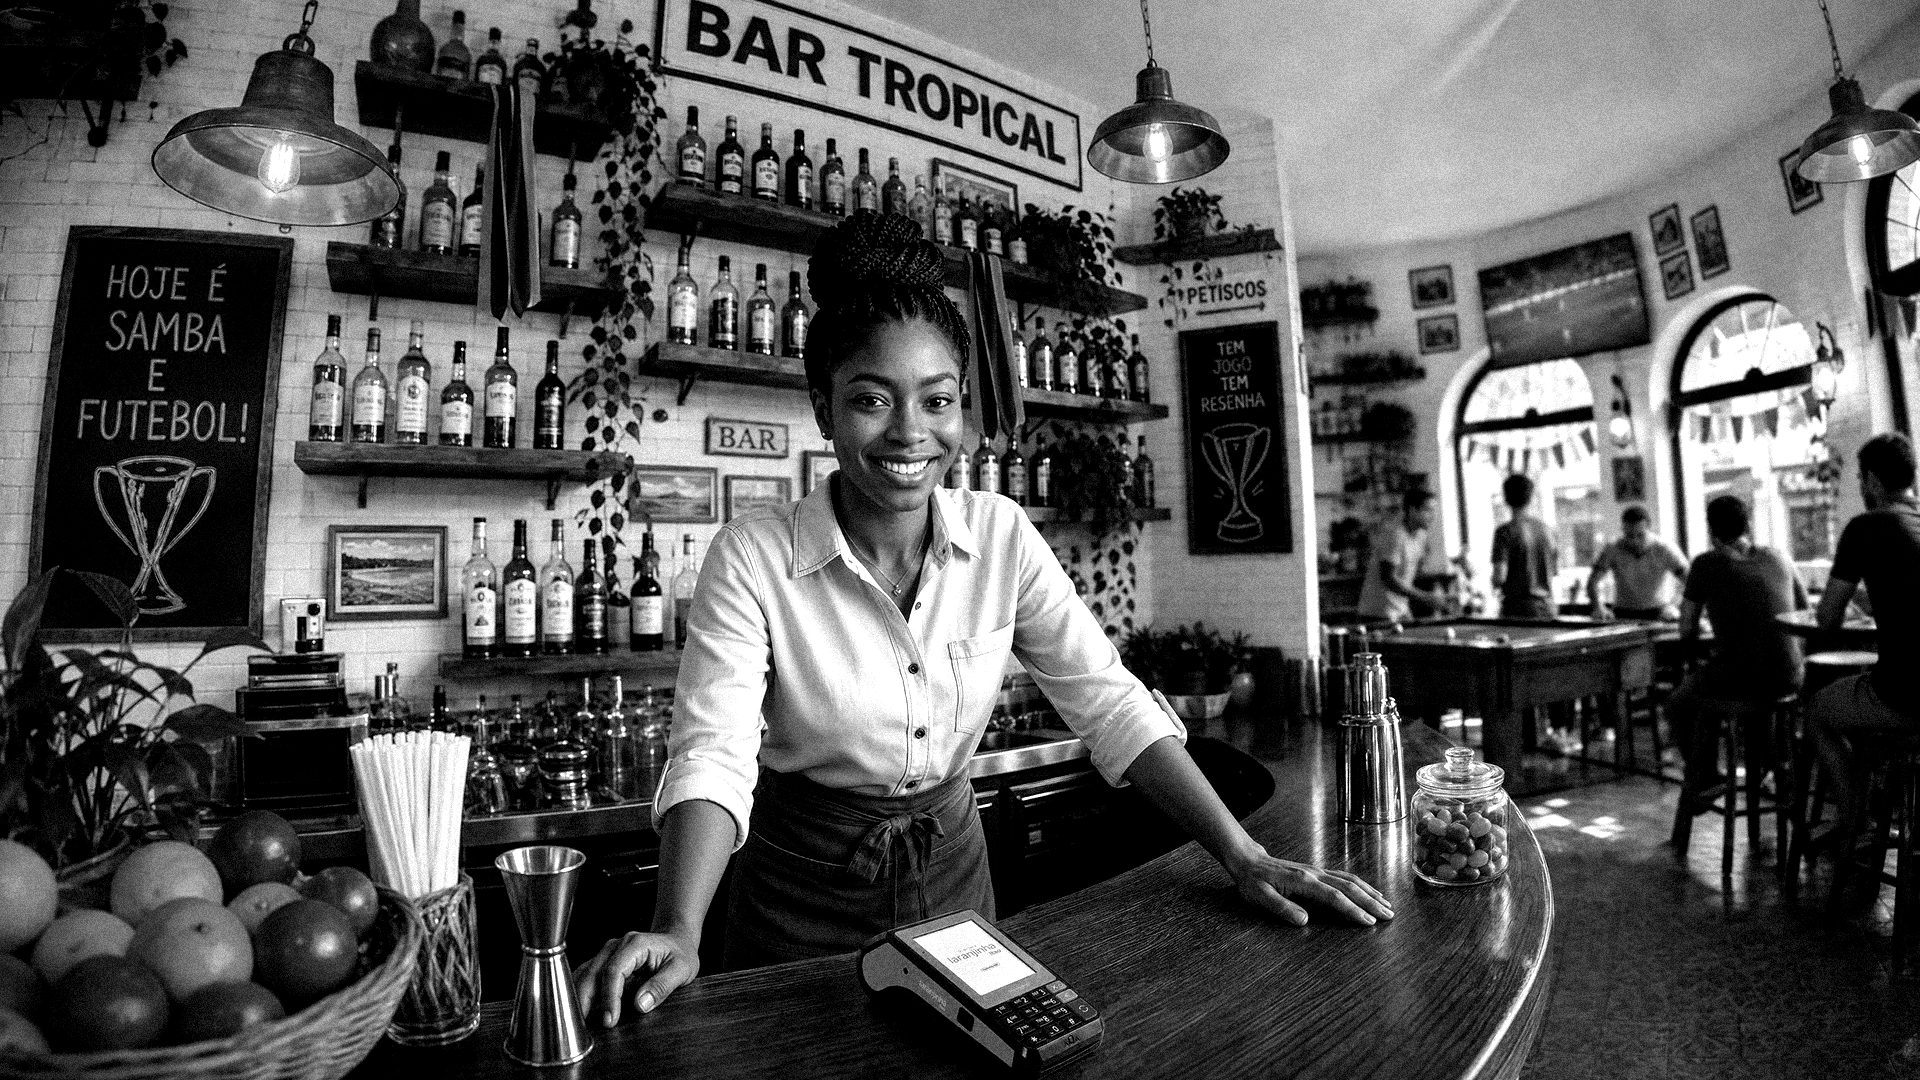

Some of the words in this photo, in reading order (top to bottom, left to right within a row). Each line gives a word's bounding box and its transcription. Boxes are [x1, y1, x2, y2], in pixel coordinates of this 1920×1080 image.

[686, 0, 827, 86] BAR
[847, 45, 1067, 165] TROPICAL
[106, 264, 190, 301] HOJE
[207, 263, 228, 302] É
[1187, 279, 1267, 304] PETISCOS
[105, 310, 227, 354] SAMBA
[1216, 339, 1246, 356] TEM
[147, 358, 167, 392] E
[1212, 356, 1252, 375] JOGO
[1220, 374, 1249, 391] TEM
[1201, 392, 1266, 413] RESENHA
[77, 399, 249, 444] FUTEBOL!
[719, 426, 777, 451] BAR
[946, 943, 997, 964] laranjinha
